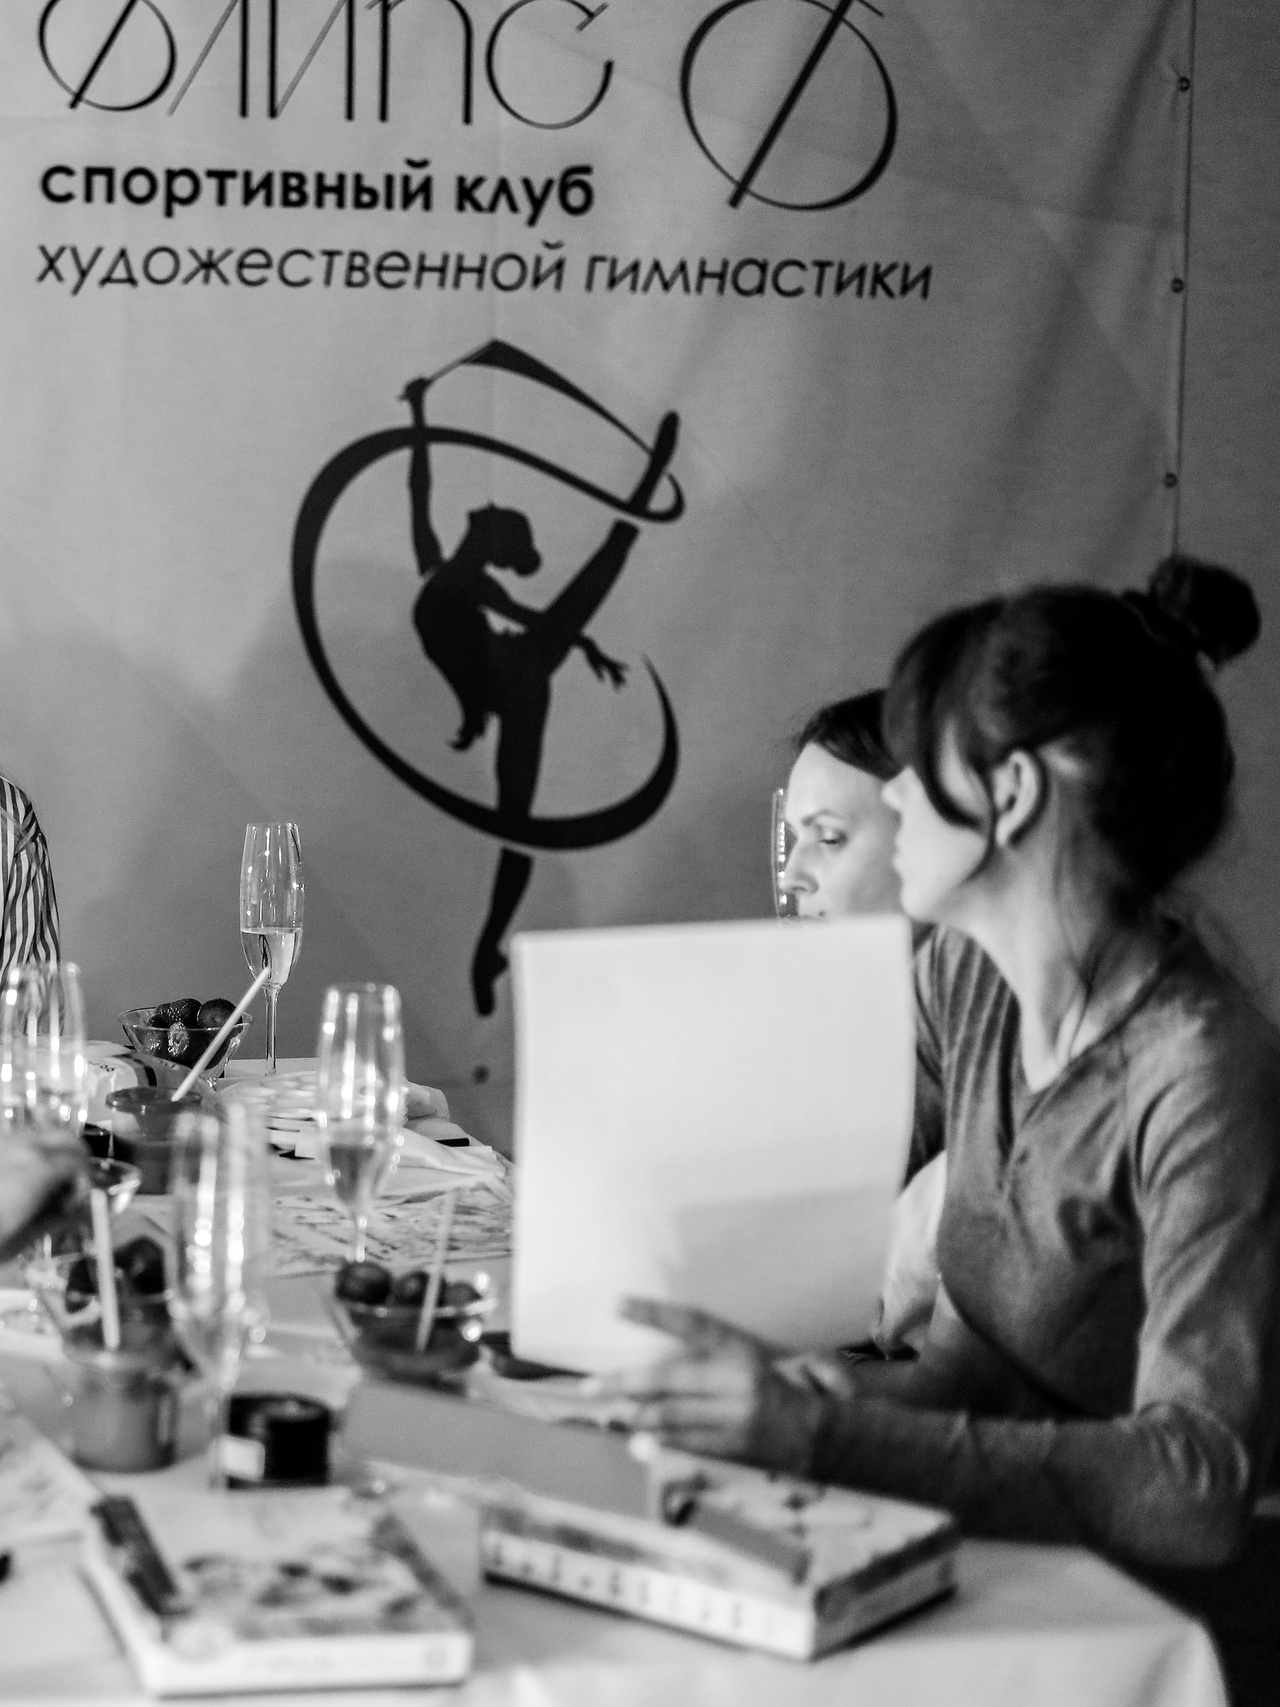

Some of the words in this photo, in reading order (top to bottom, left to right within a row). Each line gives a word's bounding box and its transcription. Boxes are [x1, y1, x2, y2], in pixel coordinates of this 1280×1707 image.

[40, 157, 433, 218] спортивный
[456, 164, 595, 227] клуб
[36, 239, 567, 296] художественной
[585, 255, 933, 300] гимнастики
